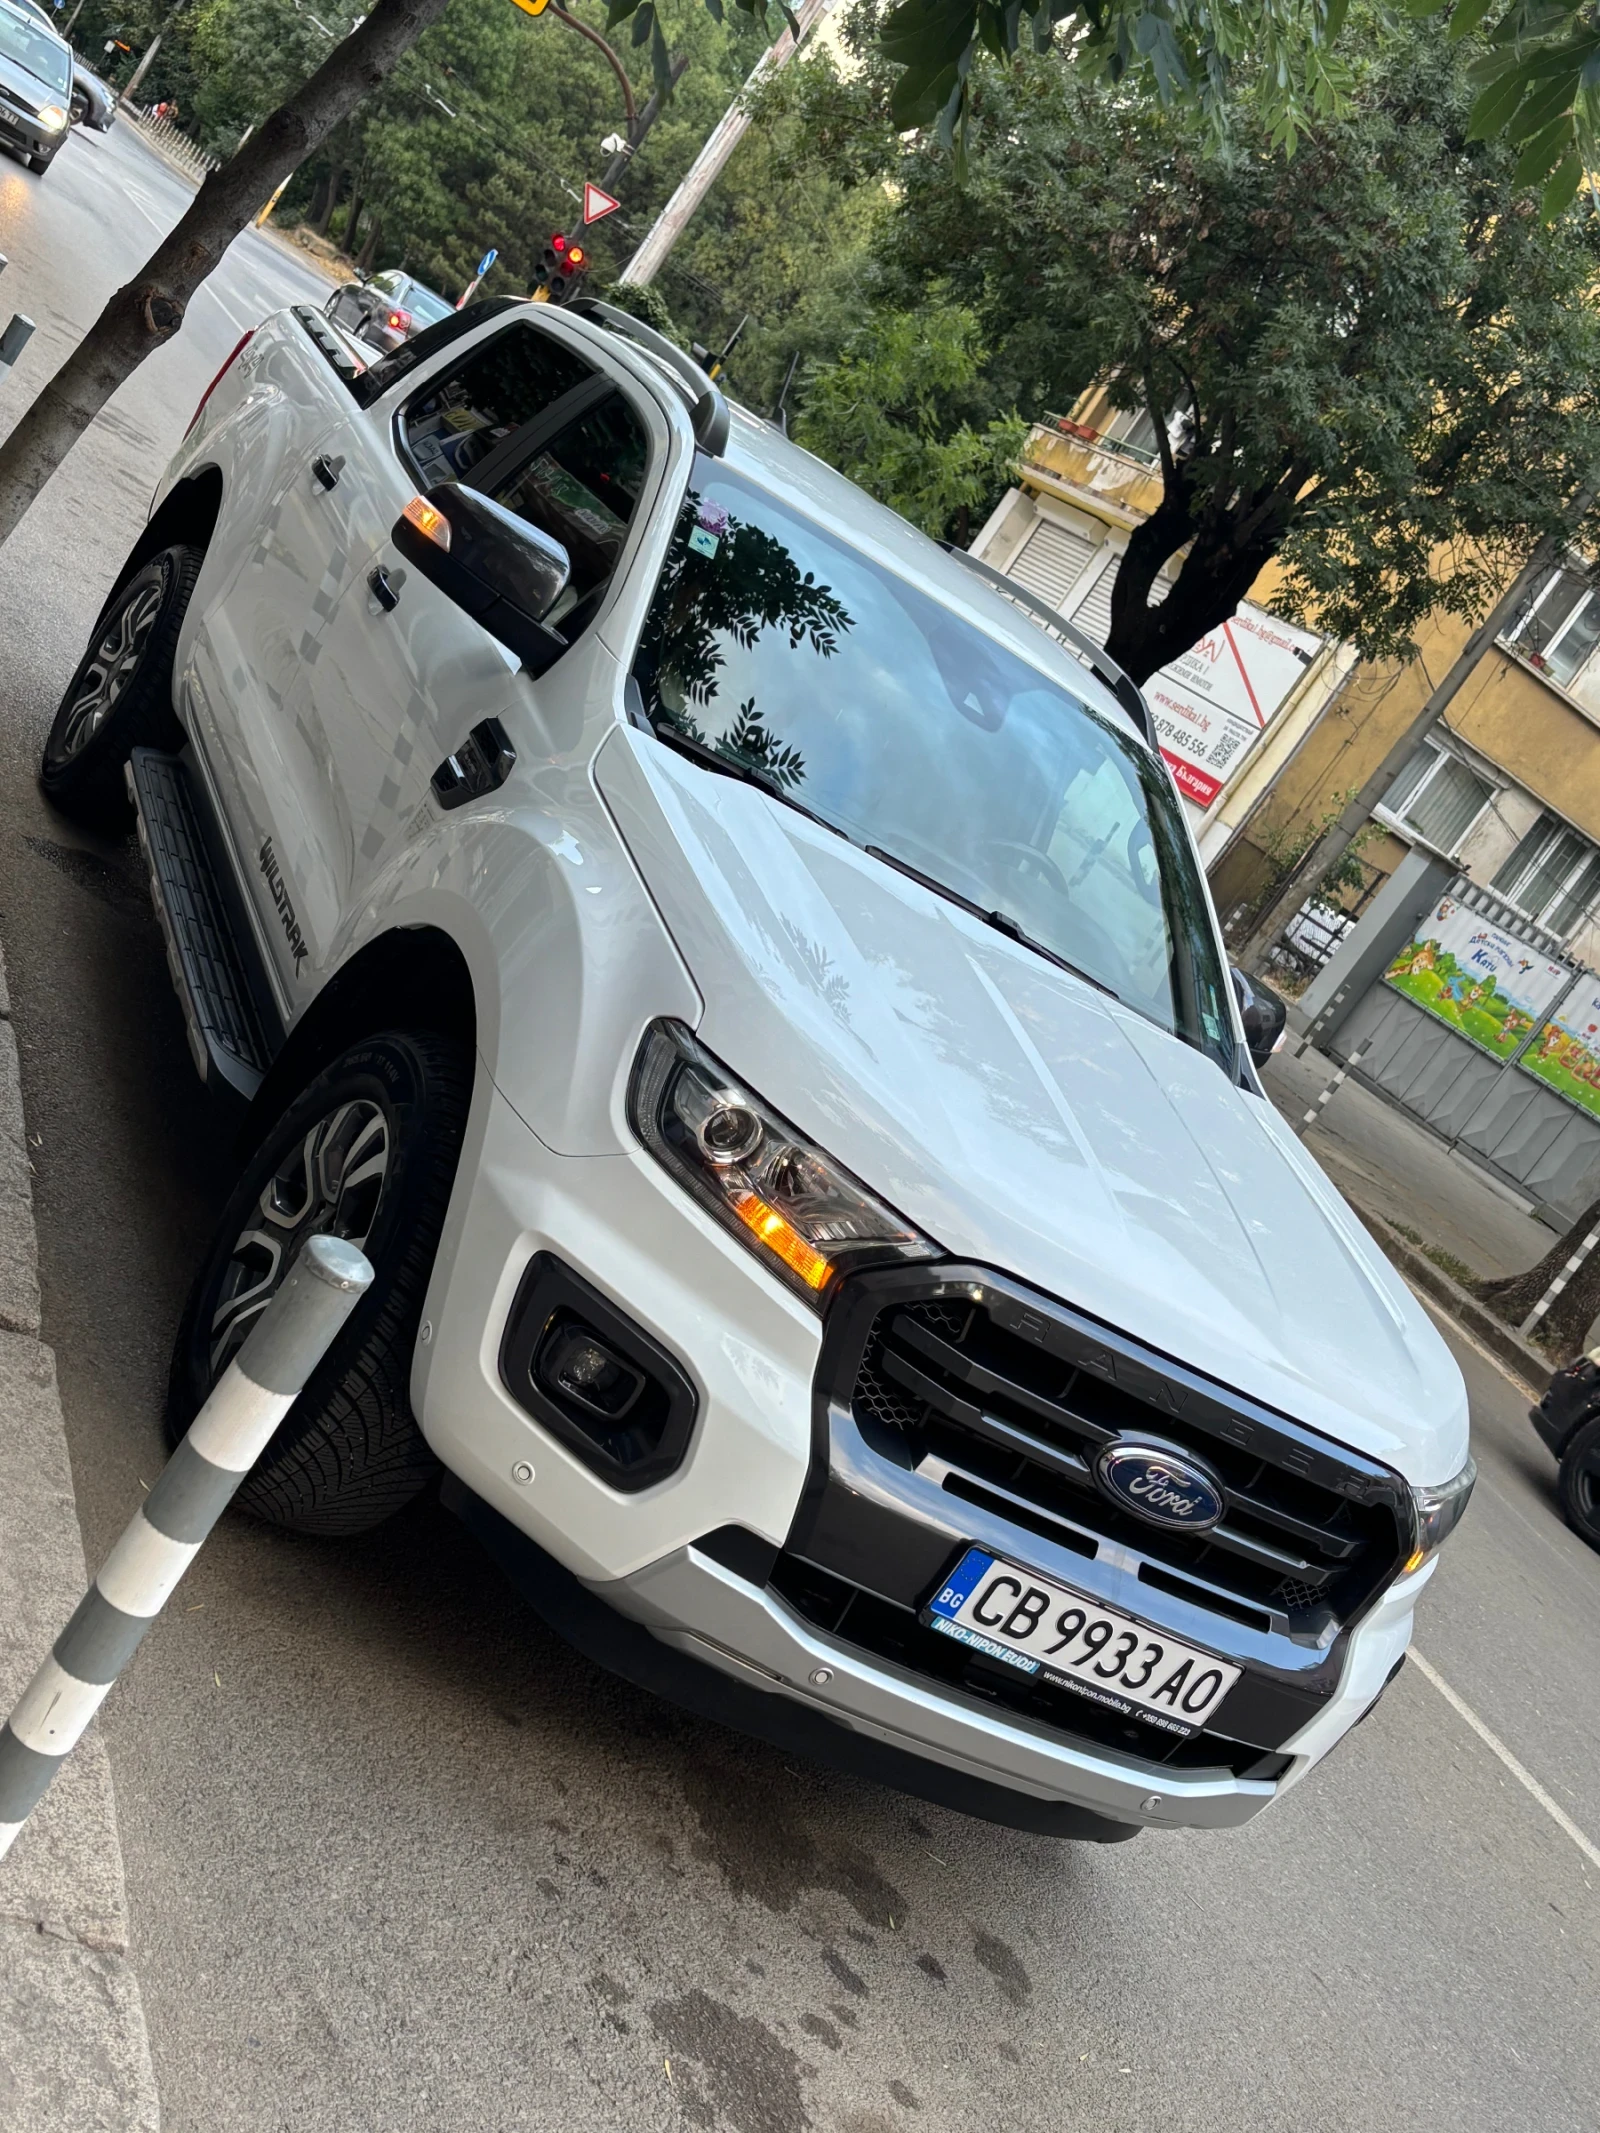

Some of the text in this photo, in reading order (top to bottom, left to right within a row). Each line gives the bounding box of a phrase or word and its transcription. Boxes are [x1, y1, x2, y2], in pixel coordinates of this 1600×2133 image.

[1156, 720, 1173, 738] 878
[1172, 728, 1190, 748] 485
[1188, 736, 1208, 758] 556
[1175, 764, 1213, 796] България
[260, 836, 309, 980] WILDTRAK
[1009, 1312, 1372, 1499] RANGER
[1128, 1465, 1203, 1517] Ford
[938, 1587, 963, 1609] BG
[934, 1618, 1005, 1658] NIKO-NIPON
[972, 1575, 1224, 1714] CB 9933 AO
